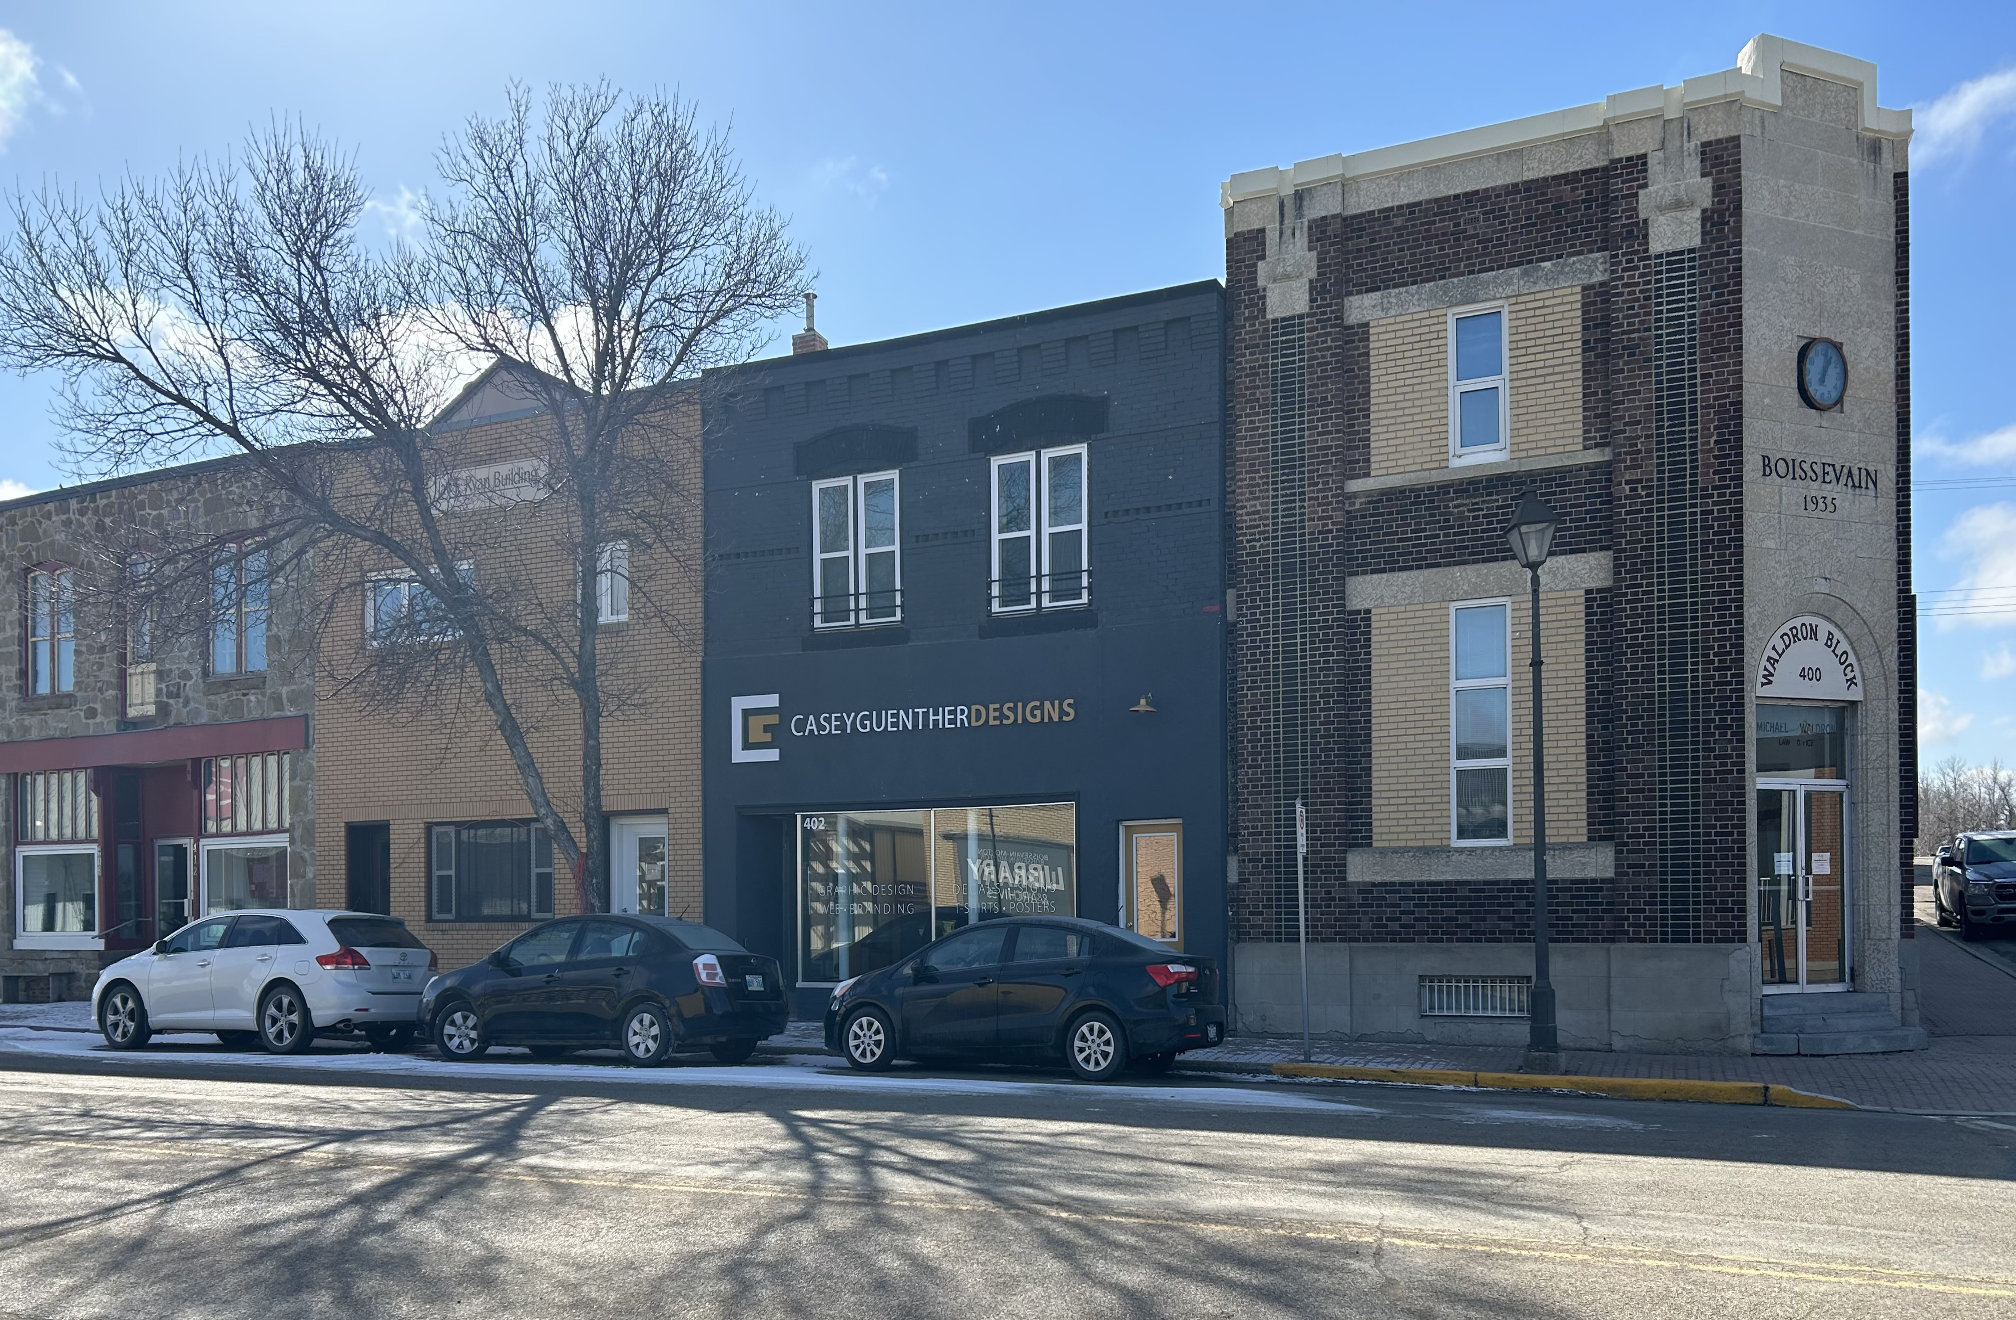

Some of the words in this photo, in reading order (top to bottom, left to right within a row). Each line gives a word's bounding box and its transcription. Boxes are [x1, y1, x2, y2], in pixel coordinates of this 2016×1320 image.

[493, 467, 541, 489] Building
[1760, 454, 1879, 491] BOISSEVAIN
[1803, 494, 1838, 514] 1935
[1760, 622, 1819, 688] WALDRON
[1824, 629, 1859, 692] BLOCK
[1798, 666, 1822, 683] 400
[1756, 721, 1789, 734] MICHAEL
[1799, 721, 1837, 735] WALDRON
[1778, 738, 1791, 746] LAW
[803, 817, 826, 831] 402
[872, 884, 914, 896] DESIGN
[1018, 882, 1057, 895] SIGNS
[821, 903, 841, 916] WEB
[849, 903, 915, 916] BRANDING
[1009, 900, 1056, 914] POSTERS
